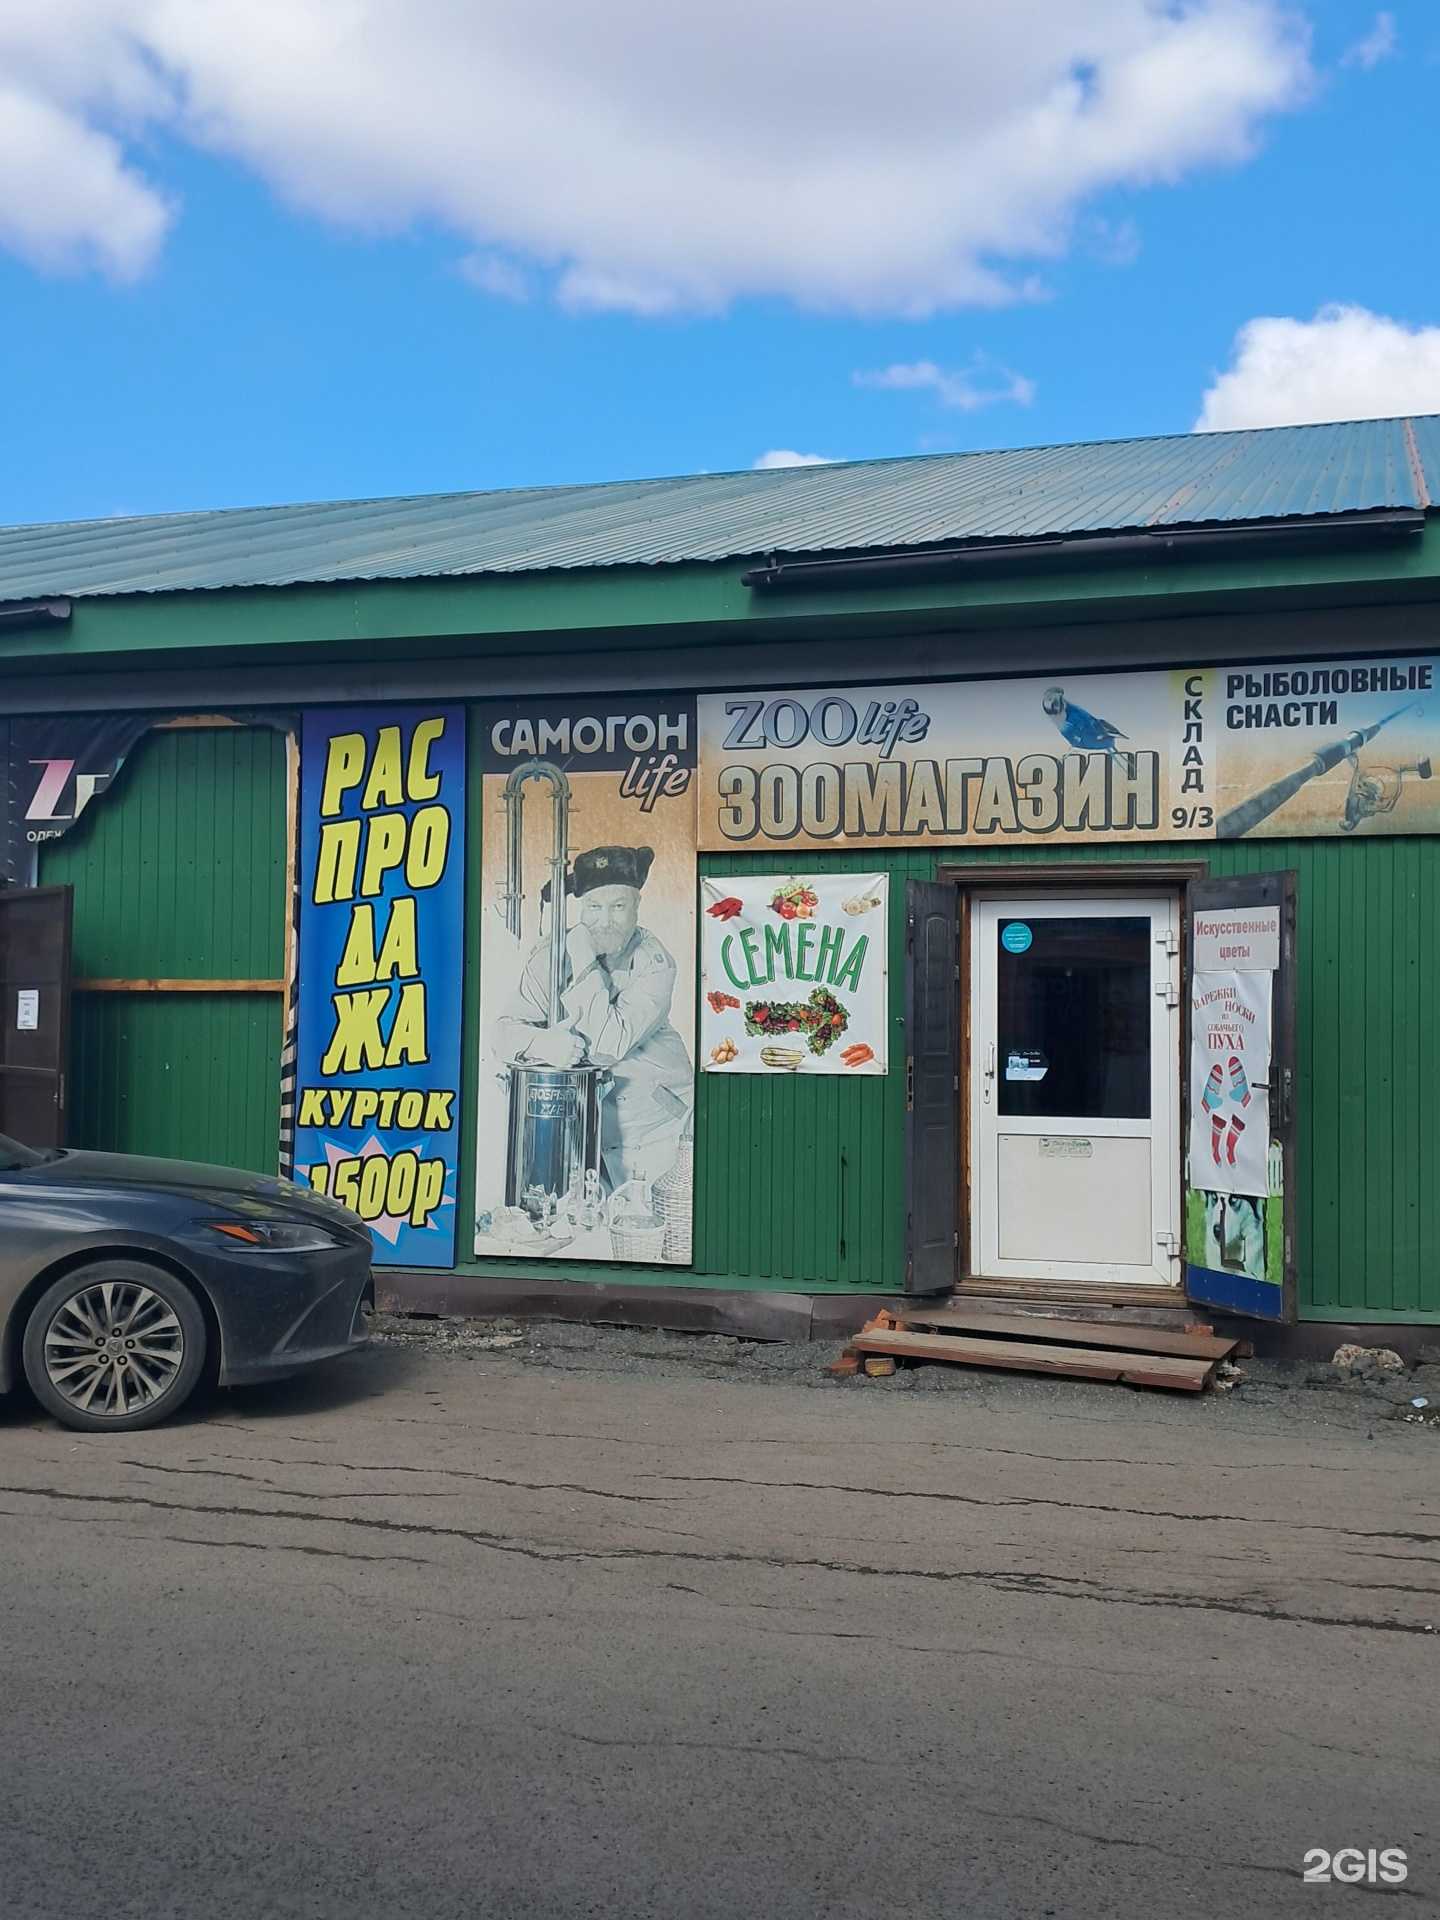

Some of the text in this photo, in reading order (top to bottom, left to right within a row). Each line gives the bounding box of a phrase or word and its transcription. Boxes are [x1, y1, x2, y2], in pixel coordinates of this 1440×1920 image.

[1227, 665, 1432, 699] РЫБОЛОВНЫЕ
[490, 712, 689, 756] САМОГОН
[722, 697, 931, 759] ZOO life
[1181, 675, 1204, 794] СКЛАД
[1226, 700, 1338, 731] СНАСТИ
[320, 717, 446, 818] РАС
[619, 753, 693, 813] life
[717, 749, 1160, 842] ЗООМАГАЗИН
[1171, 806, 1214, 830] 9/3
[313, 804, 452, 904] ПРО
[336, 896, 421, 987] ДА
[720, 921, 870, 993] СЕМЕНА
[1196, 921, 1277, 938] Искусственные
[1219, 945, 1251, 960] цветы
[320, 980, 428, 1075] ЖА
[1208, 1033, 1245, 1051] ПУХА
[298, 1087, 454, 1132] КУРТОК
